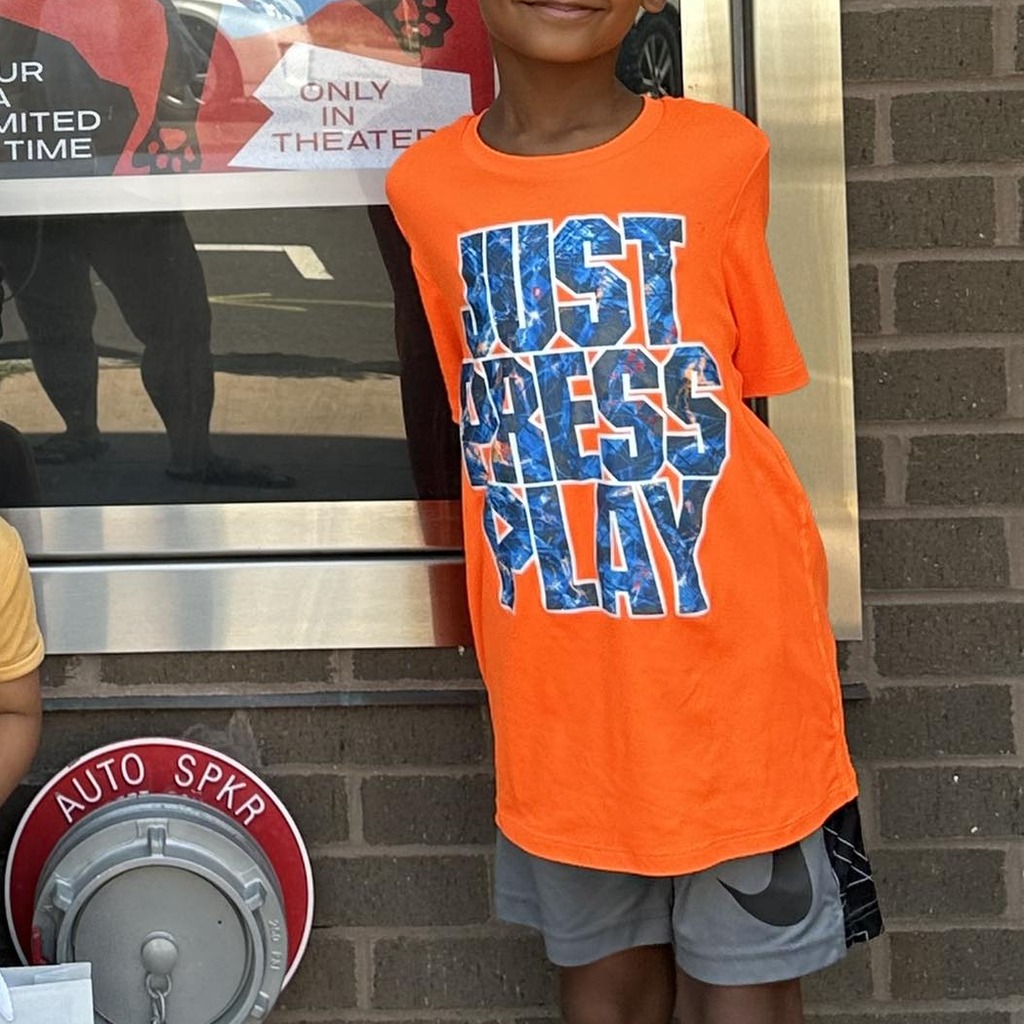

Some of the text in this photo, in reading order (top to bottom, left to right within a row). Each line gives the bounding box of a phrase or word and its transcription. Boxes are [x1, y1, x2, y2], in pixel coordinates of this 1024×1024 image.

[300, 80, 391, 102] ONLY
[323, 105, 355, 127] IN
[4, 138, 93, 162] TIME
[457, 213, 686, 356] JUST
[460, 342, 730, 487] PRESS
[483, 476, 711, 619] PLAY
[54, 753, 266, 826] AUTO SPKR
